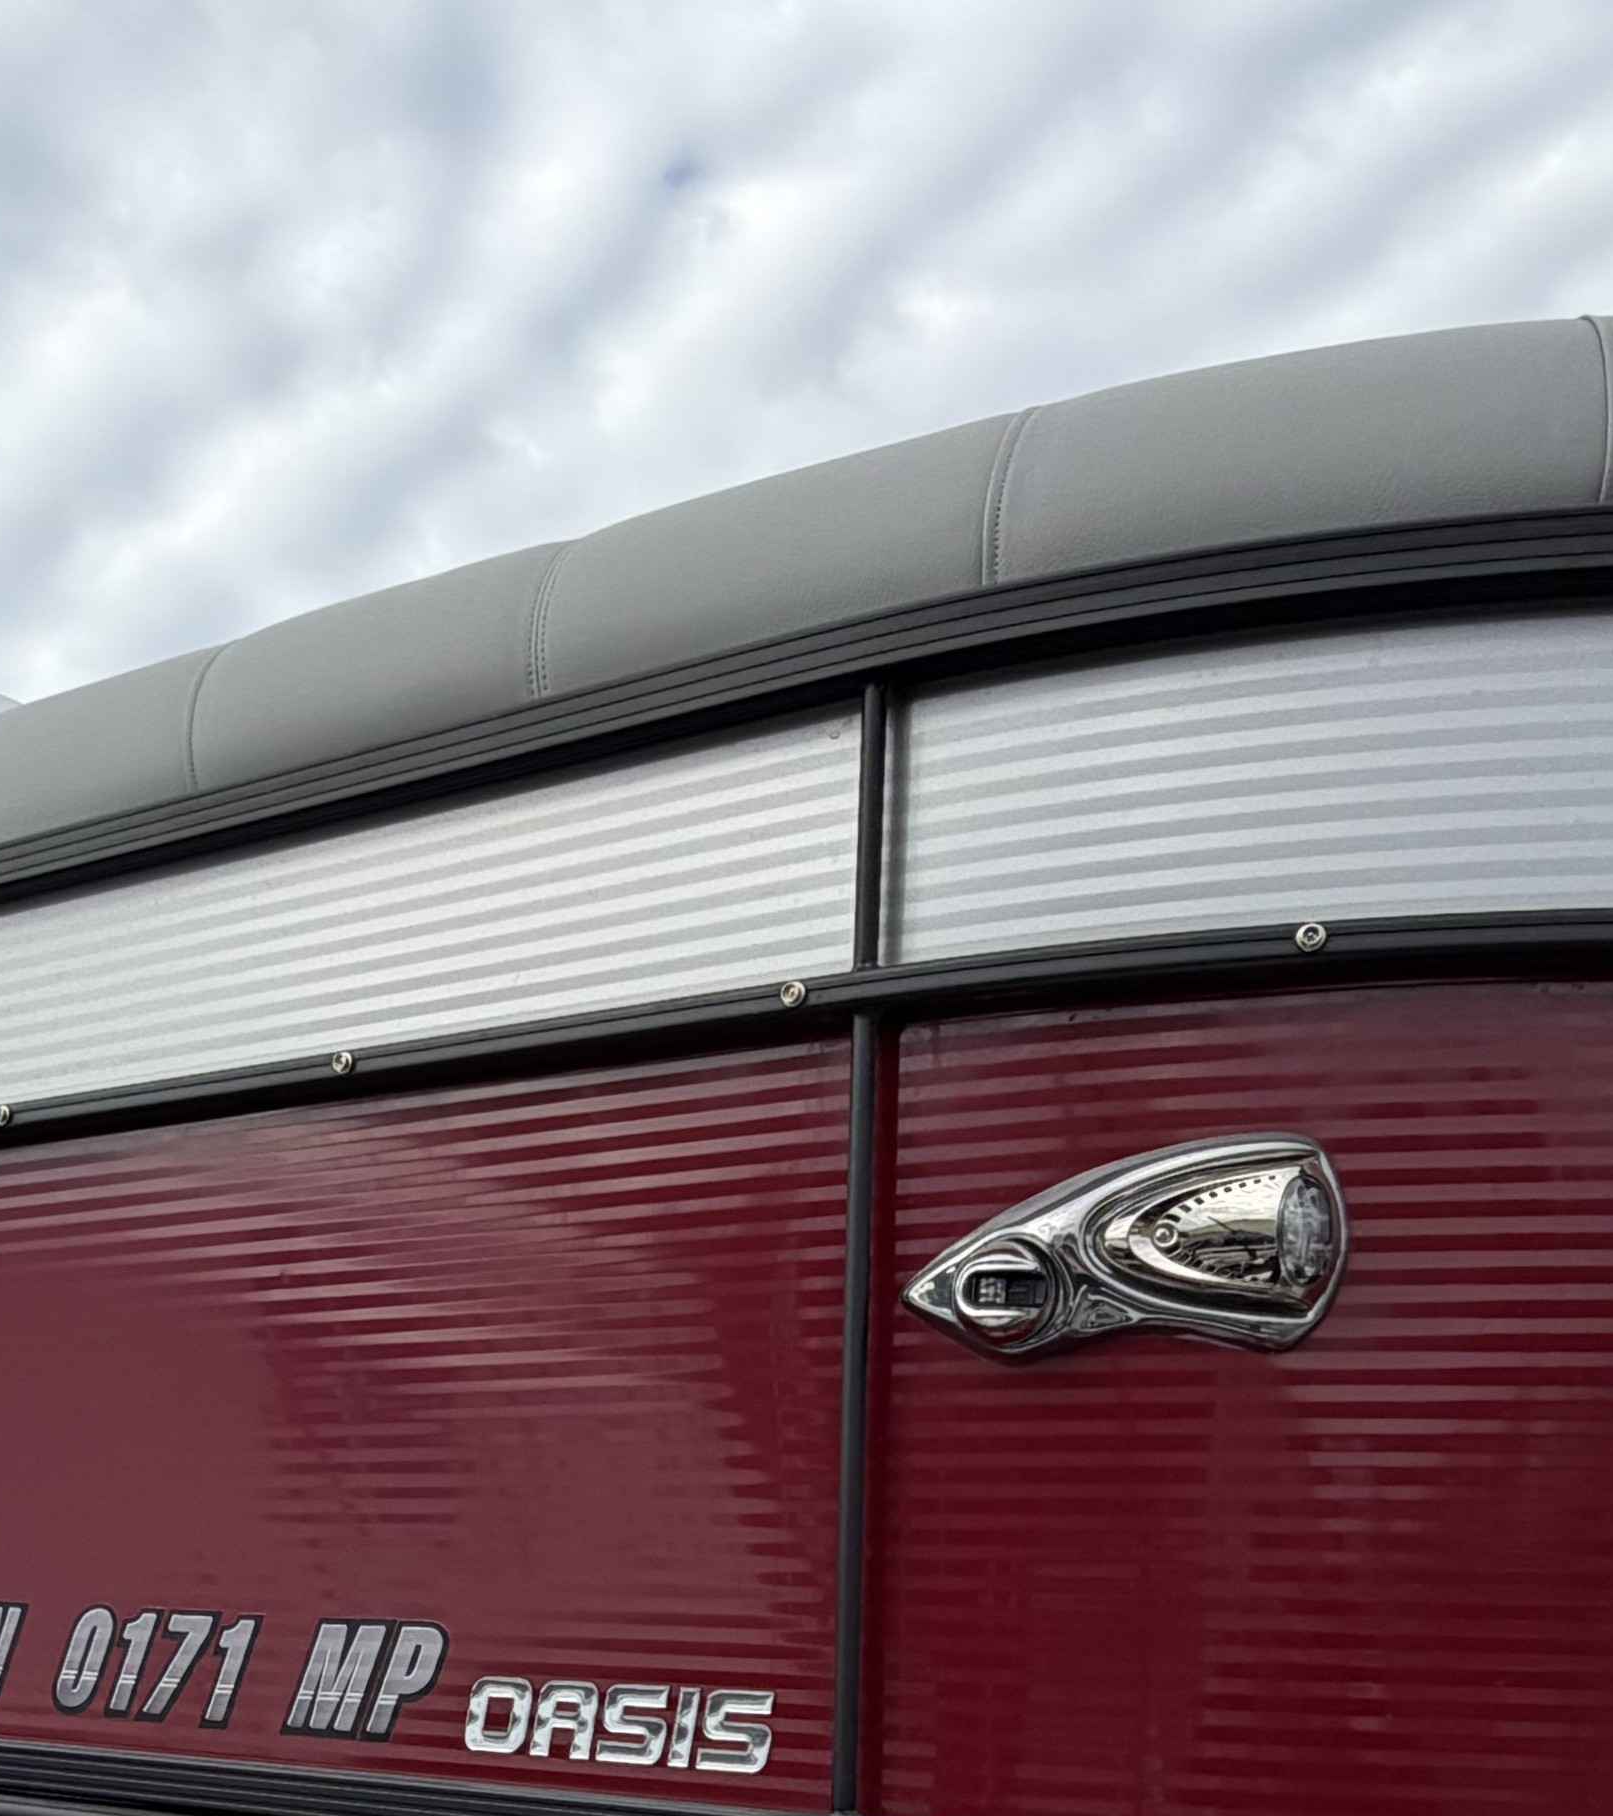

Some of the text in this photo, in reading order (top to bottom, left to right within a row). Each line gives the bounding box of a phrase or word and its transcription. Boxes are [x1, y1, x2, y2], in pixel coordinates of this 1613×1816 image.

[50, 1603, 263, 1729] 0171
[281, 1618, 451, 1743] MP
[464, 1676, 776, 1775] OASIS
